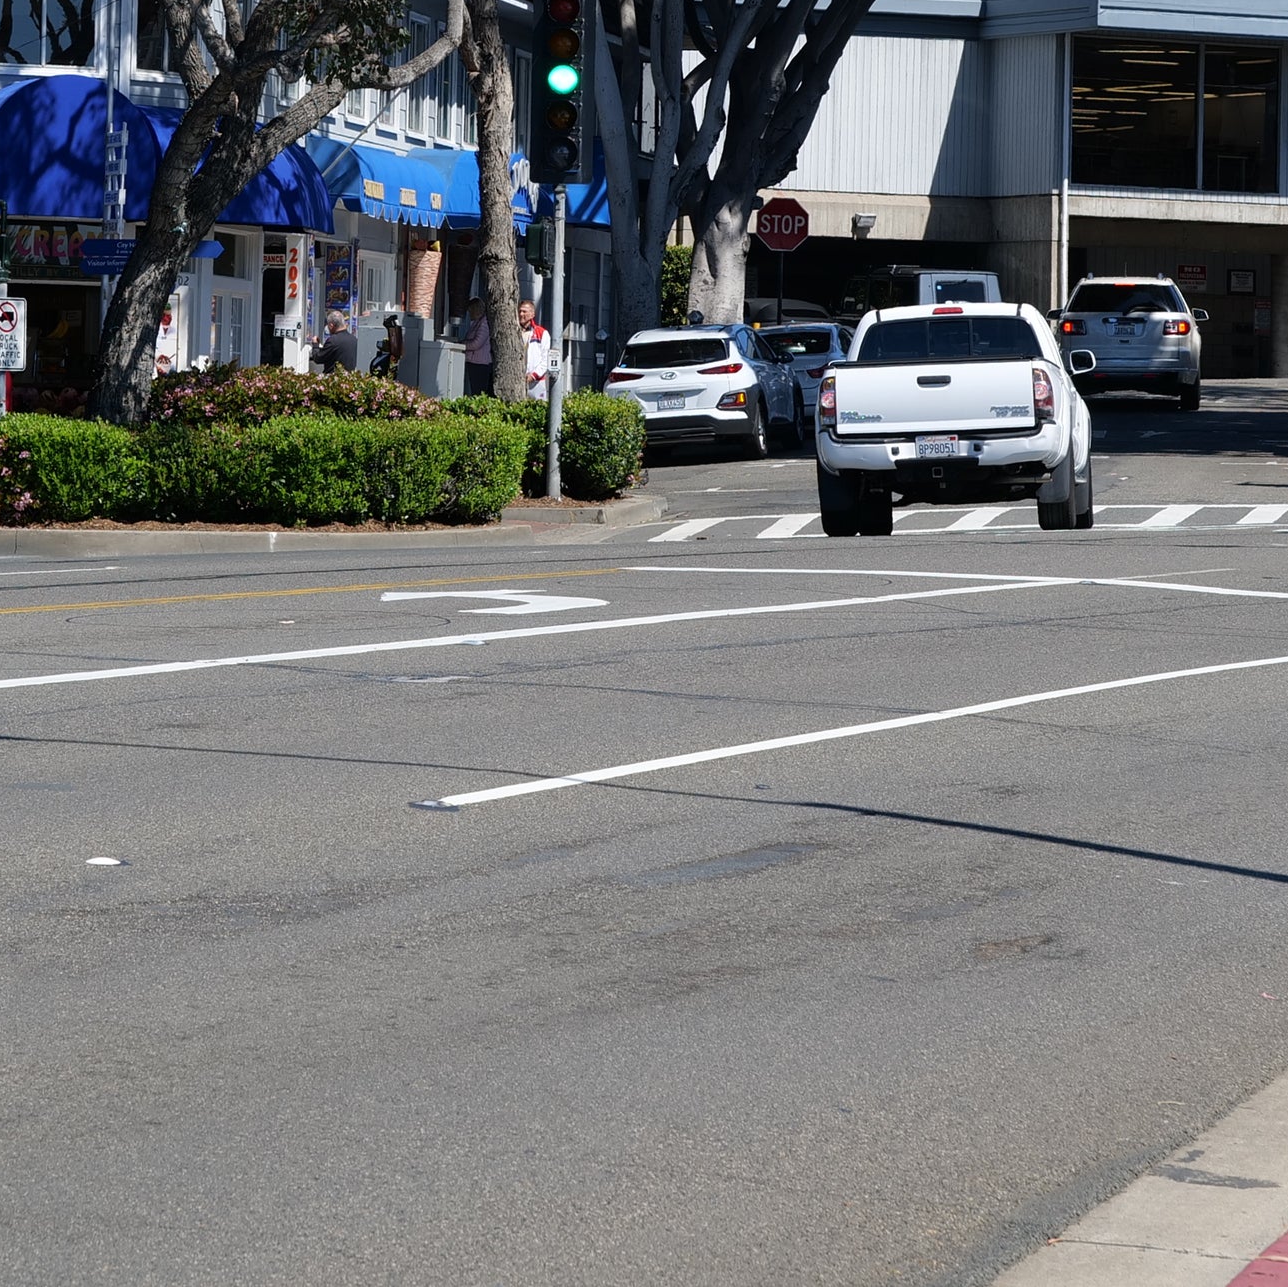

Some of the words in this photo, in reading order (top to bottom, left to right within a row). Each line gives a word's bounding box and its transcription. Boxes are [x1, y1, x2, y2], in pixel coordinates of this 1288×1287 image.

[759, 214, 806, 234] STOP
[287, 247, 299, 300] 202
[274, 328, 297, 337] FEET
[296, 322, 302, 330] 6
[918, 442, 956, 455] 8P98051
